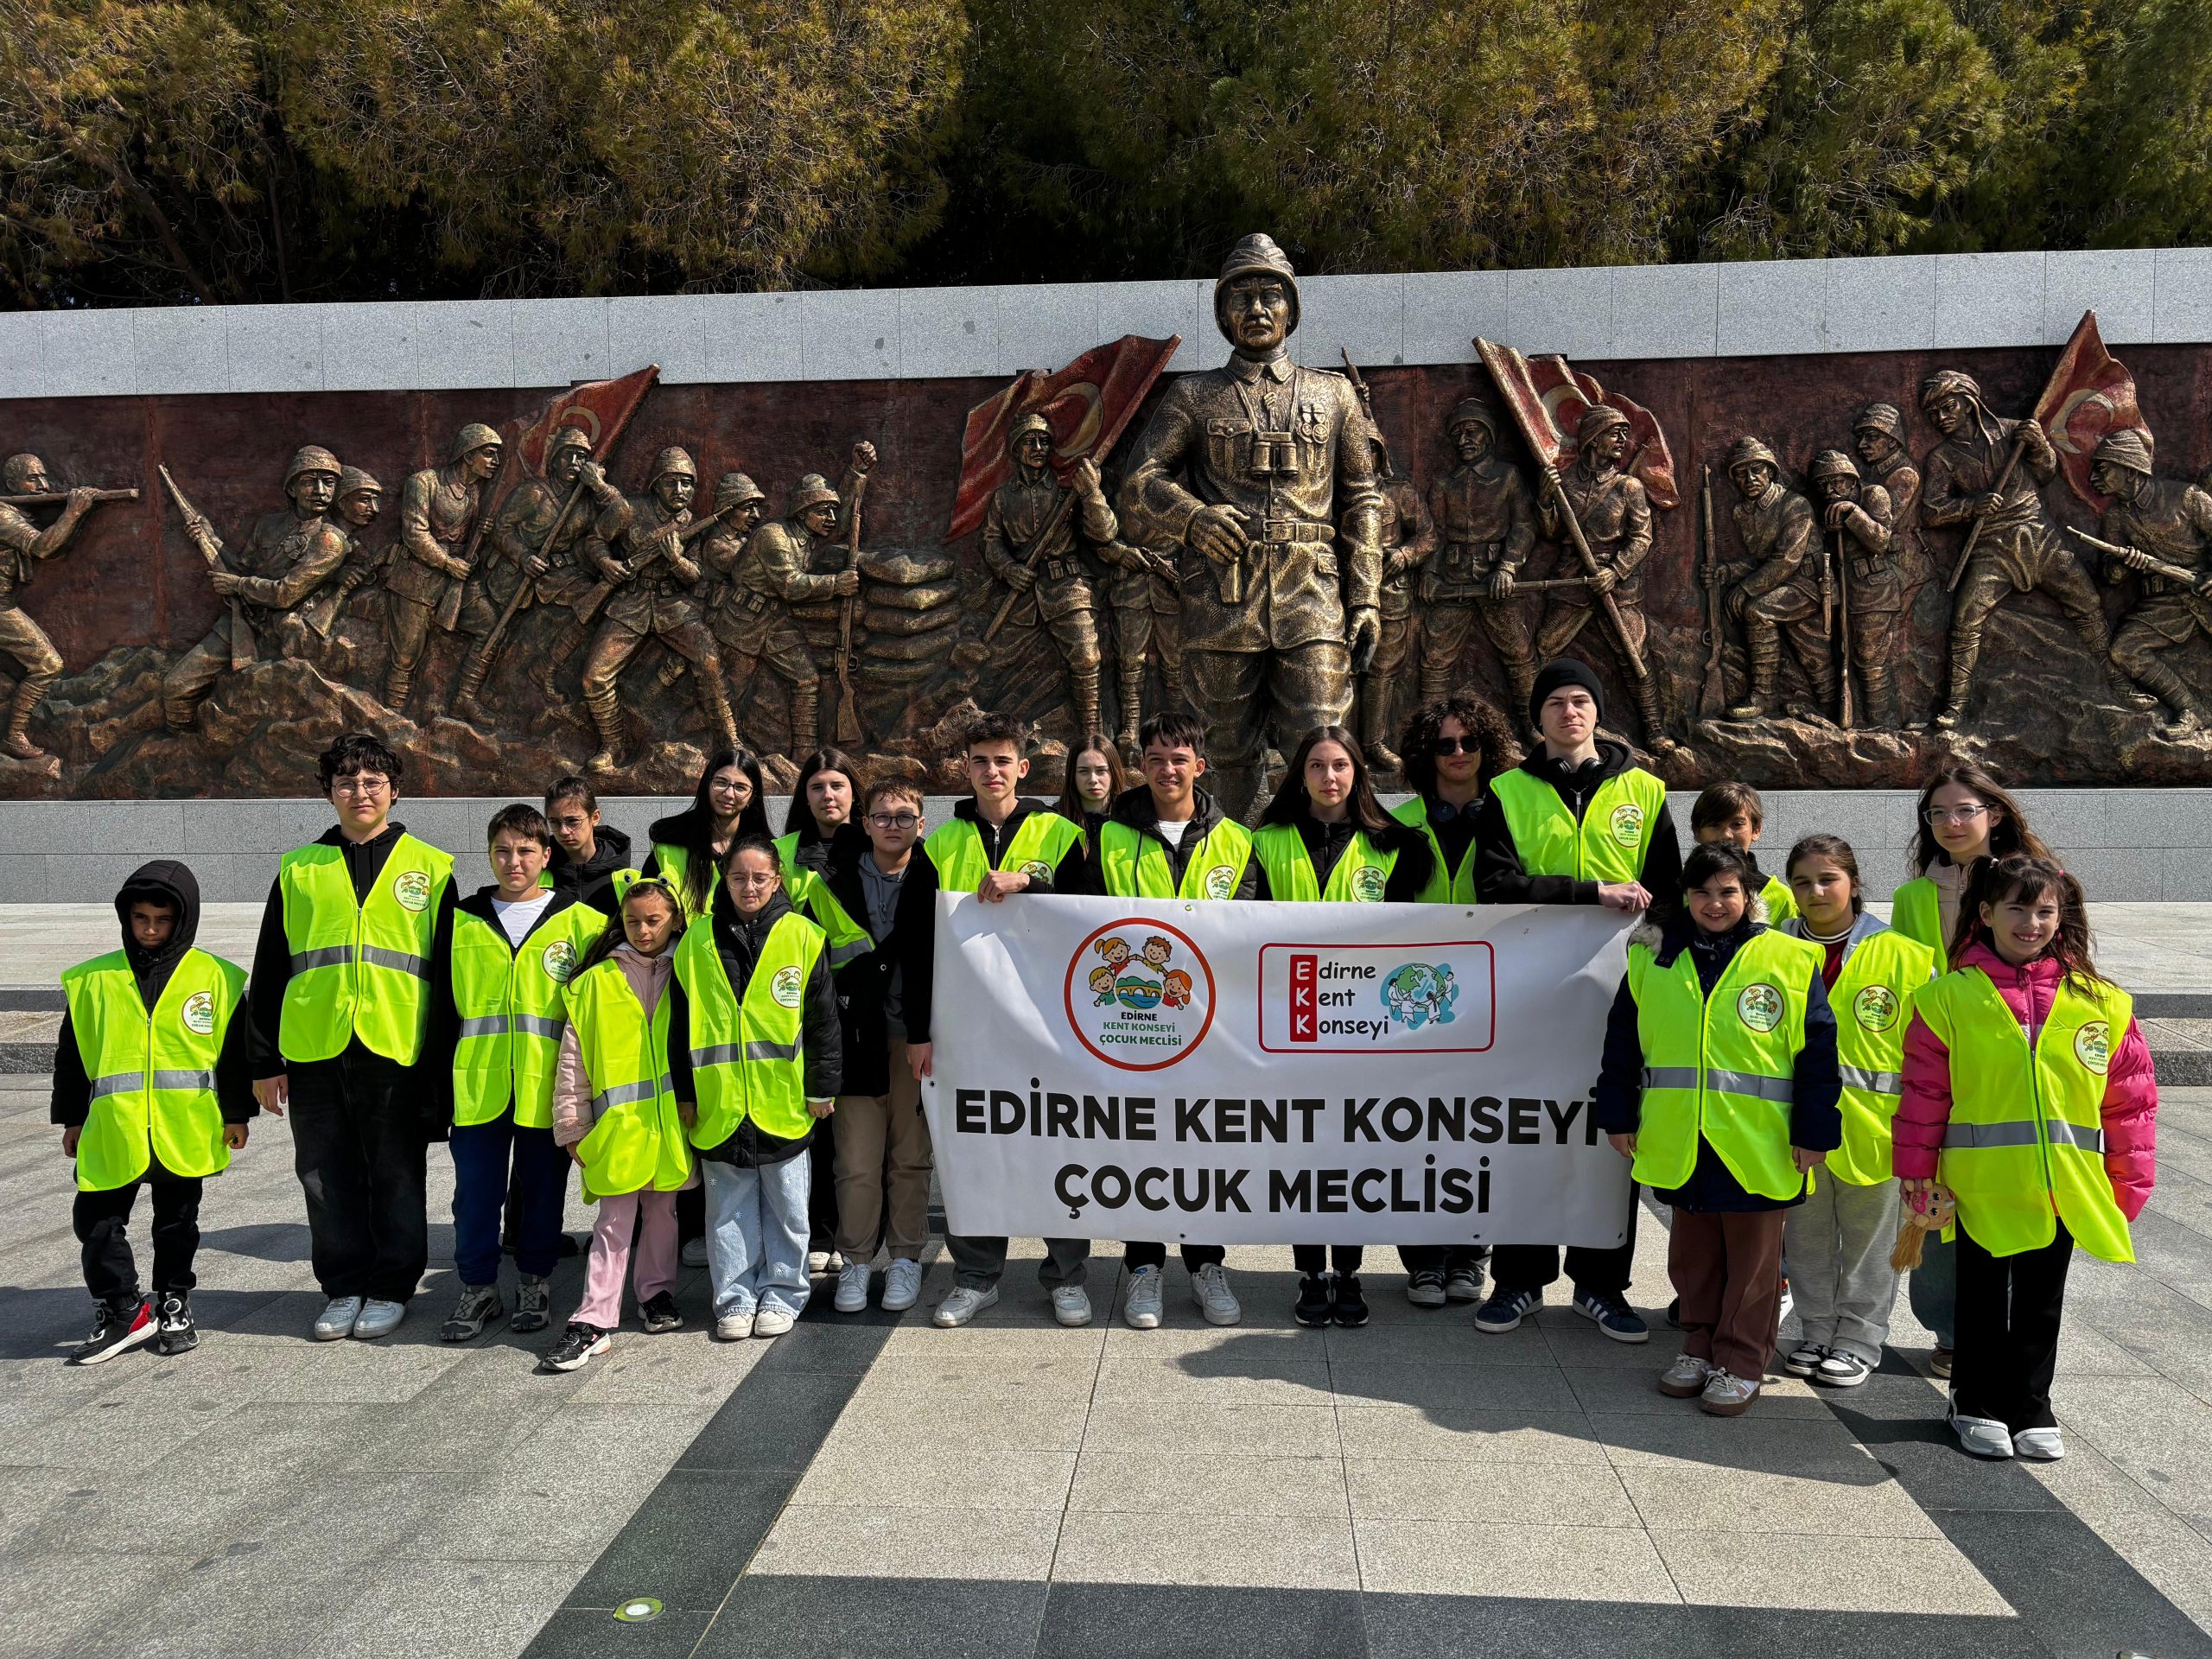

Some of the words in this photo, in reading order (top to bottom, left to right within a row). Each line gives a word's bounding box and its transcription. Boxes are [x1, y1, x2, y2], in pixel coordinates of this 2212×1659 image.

[1296, 961, 1376, 981] Edirne
[1296, 987, 1356, 1007] Kent
[1121, 1010, 1158, 1021] EDİRNE
[1103, 1021, 1130, 1031] KENT
[1131, 1022, 1176, 1033] KONSEYİ
[1296, 1014, 1389, 1040] Konseyi
[1099, 1034, 1137, 1046] ÇOCUK
[1139, 1034, 1182, 1046] MECLİSİ
[956, 1077, 1157, 1141] EDİRNE
[1174, 1098, 1325, 1143] KENT
[1344, 1087, 1598, 1147] KONSEYİ
[1054, 1163, 1252, 1219] ÇOCUK
[1268, 1154, 1491, 1214] MECLİSİ
